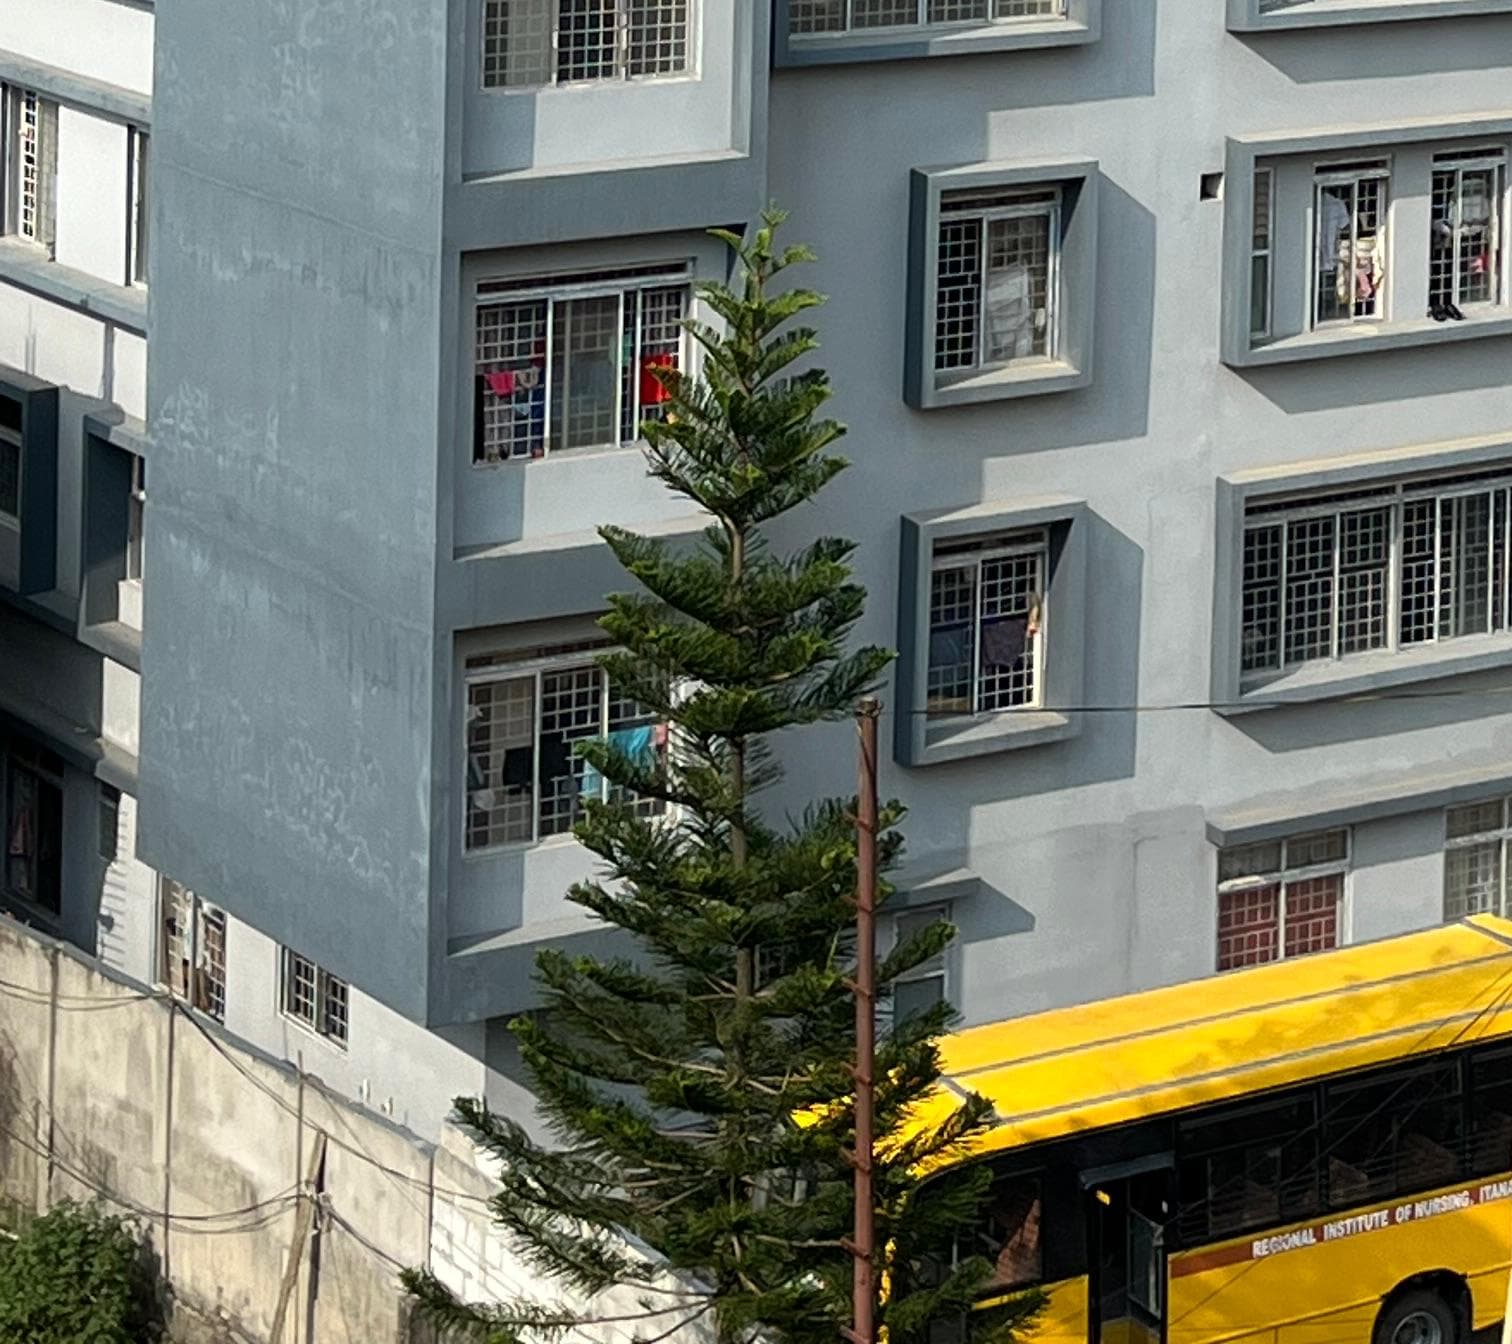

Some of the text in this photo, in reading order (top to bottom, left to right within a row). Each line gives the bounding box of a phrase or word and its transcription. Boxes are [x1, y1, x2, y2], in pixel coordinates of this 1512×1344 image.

[1252, 1228, 1317, 1259] REGIONAL
[1323, 1209, 1389, 1241] INSTITUTE
[1395, 1203, 1413, 1224] OF
